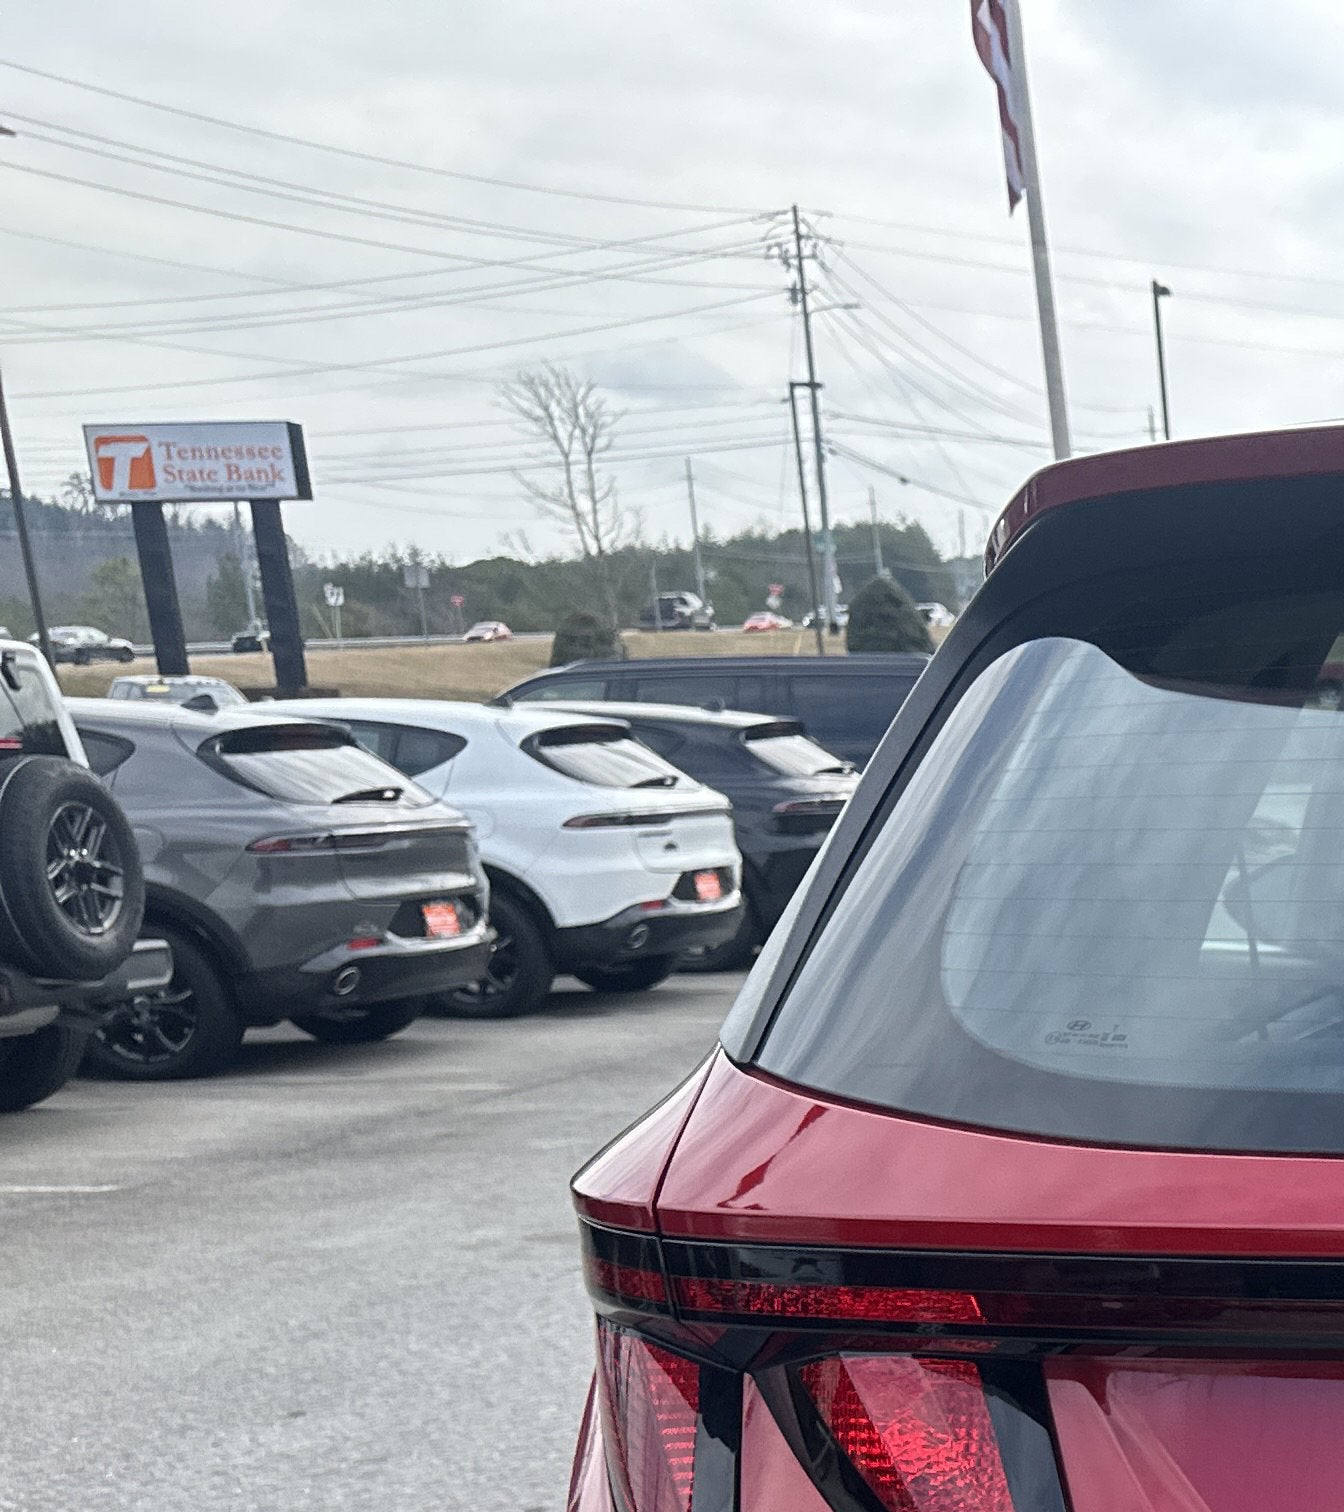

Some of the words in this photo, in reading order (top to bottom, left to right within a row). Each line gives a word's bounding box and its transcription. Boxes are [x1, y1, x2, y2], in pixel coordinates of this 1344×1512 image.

[157, 441, 284, 461] Tennessee
[162, 463, 219, 484] State
[224, 462, 285, 483] Bank
